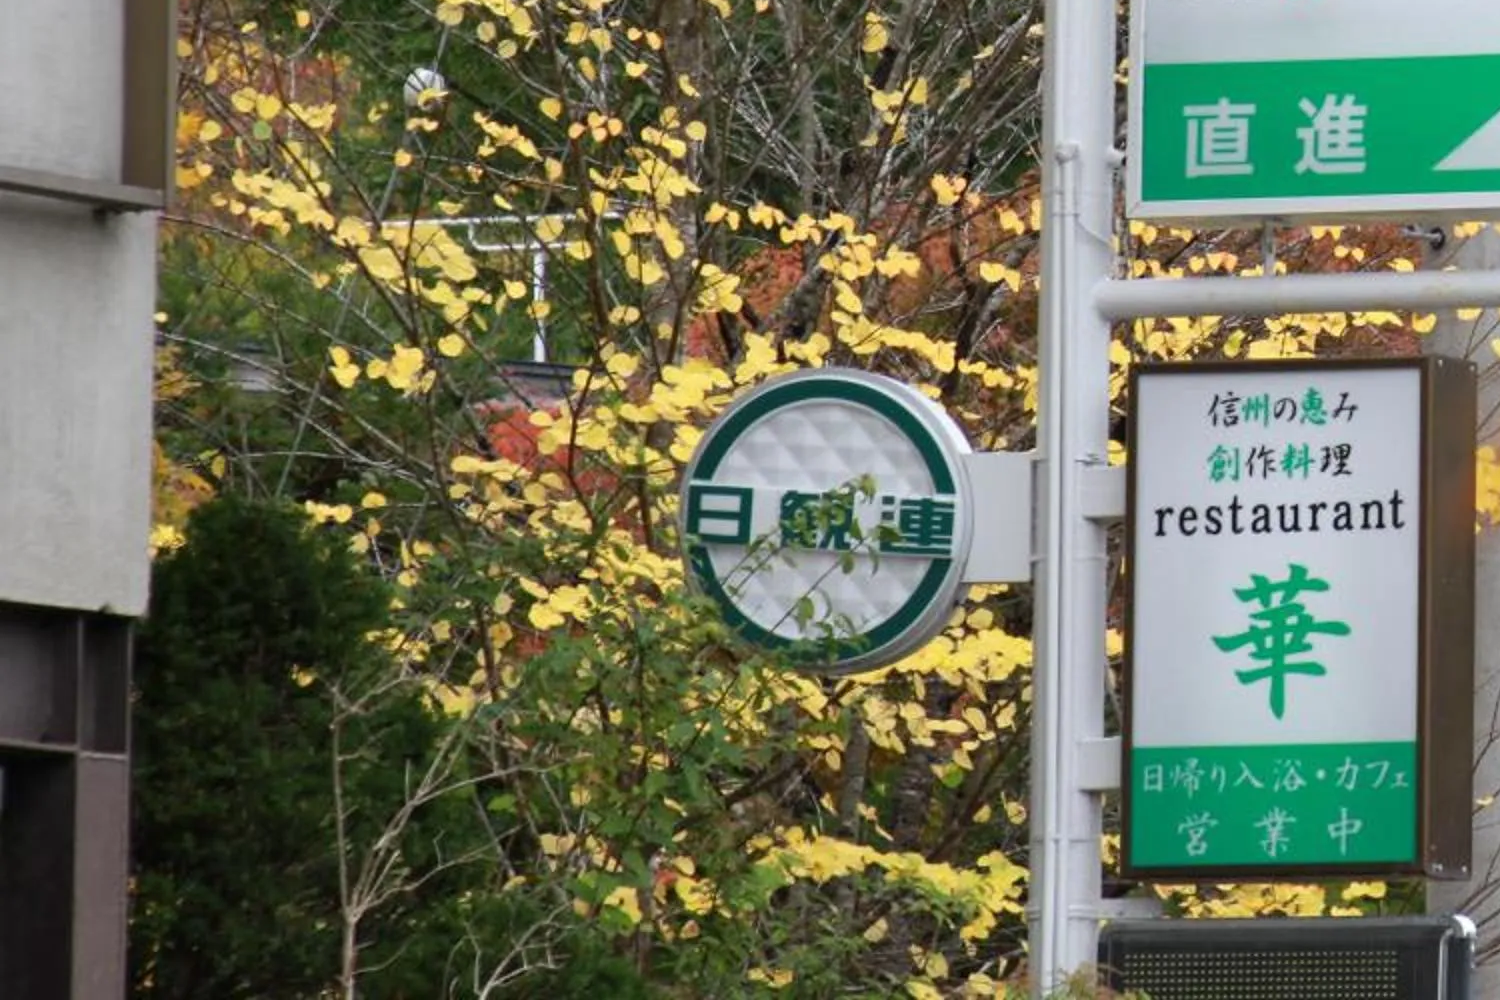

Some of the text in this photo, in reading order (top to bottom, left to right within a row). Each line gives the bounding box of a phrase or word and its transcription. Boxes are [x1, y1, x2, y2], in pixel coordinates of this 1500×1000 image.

[1183, 93, 1368, 179] 直進
[1206, 386, 1359, 429] 信州の恵み
[1206, 442, 1354, 483] 創作料理
[1153, 489, 1406, 537] restaurant
[1211, 563, 1352, 720] 華
[1142, 756, 1410, 799] 日帰り入浴・カフェ
[1177, 806, 1364, 858] 営業中
